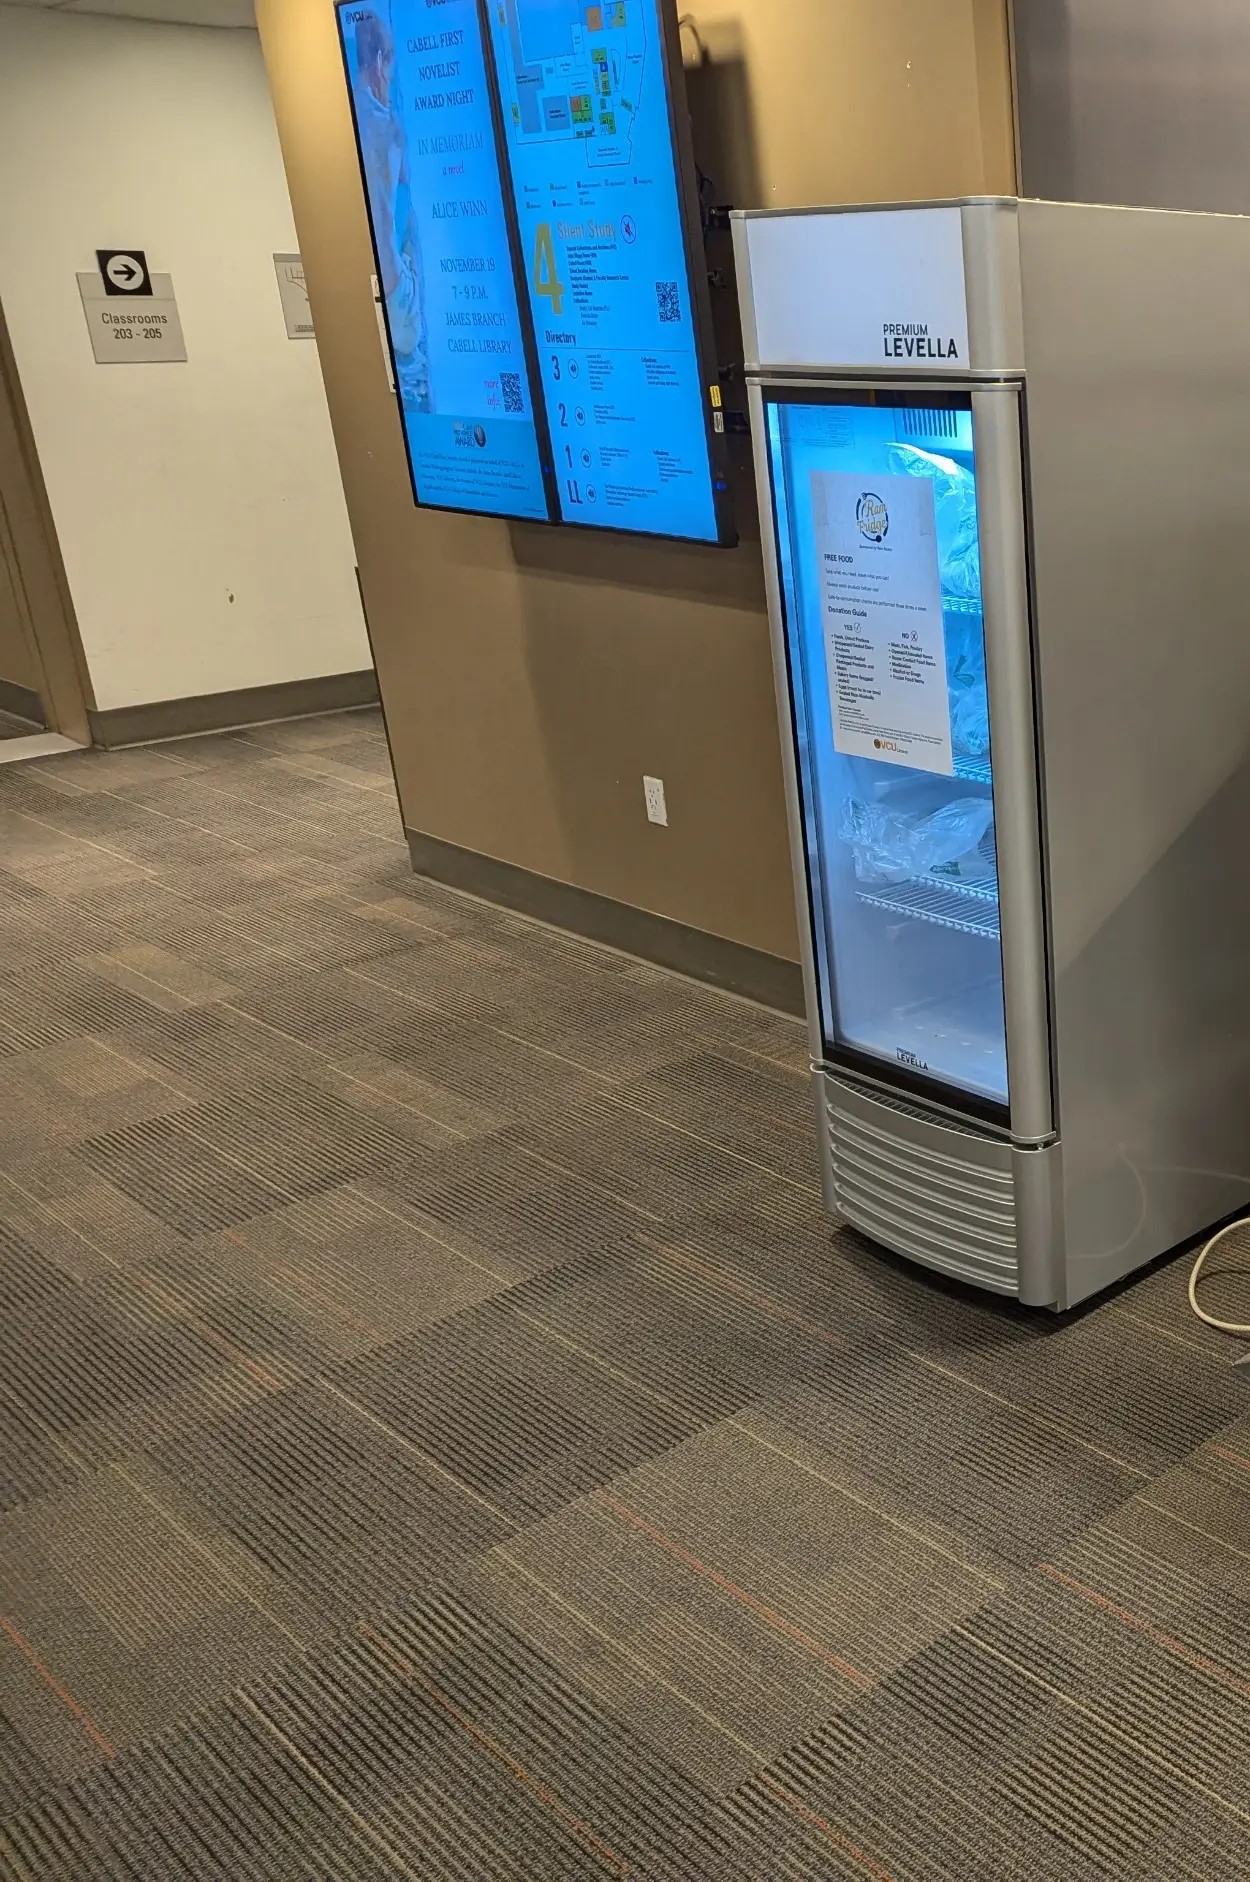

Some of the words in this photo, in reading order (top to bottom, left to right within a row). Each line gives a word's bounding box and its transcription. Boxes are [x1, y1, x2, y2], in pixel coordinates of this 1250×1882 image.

[407, 35, 439, 54] CABELL
[440, 30, 464, 48] FIRST
[419, 61, 460, 82] NOVELIST
[415, 93, 445, 111] AWARD
[446, 89, 474, 106] NIGHT
[418, 139, 429, 156] IN
[430, 132, 484, 155] MEMORIAM
[432, 201, 459, 219] ALICE
[460, 200, 488, 217] WINN
[557, 222, 584, 240] Silent
[587, 220, 616, 241] Study
[440, 258, 487, 273] NOVEMBER
[487, 257, 496, 272] 19
[534, 223, 564, 315] 4
[451, 286, 457, 300] 7
[464, 285, 470, 300] 9
[101, 312, 168, 325] Classrooms
[446, 313, 471, 326] JAMES
[472, 312, 506, 327] BRANCH
[113, 328, 133, 340] 203
[143, 328, 162, 340] 205
[545, 330, 576, 346] Directory
[883, 324, 929, 336] PREMIUM
[448, 339, 478, 353] CABELL
[480, 339, 512, 354] LIBRARY
[884, 338, 959, 359] LEVELLA
[551, 355, 561, 381] 3
[558, 402, 568, 428] 2
[565, 445, 572, 469] 1
[567, 480, 583, 504] LL
[864, 500, 887, 518] Ram
[857, 517, 887, 535] Fridge
[824, 553, 838, 562] FREE
[838, 555, 854, 563] FOOD
[828, 606, 851, 616] Donation
[852, 608, 867, 617] Guide
[880, 741, 897, 752] VCU
[896, 1053, 929, 1071] LEVELLA
